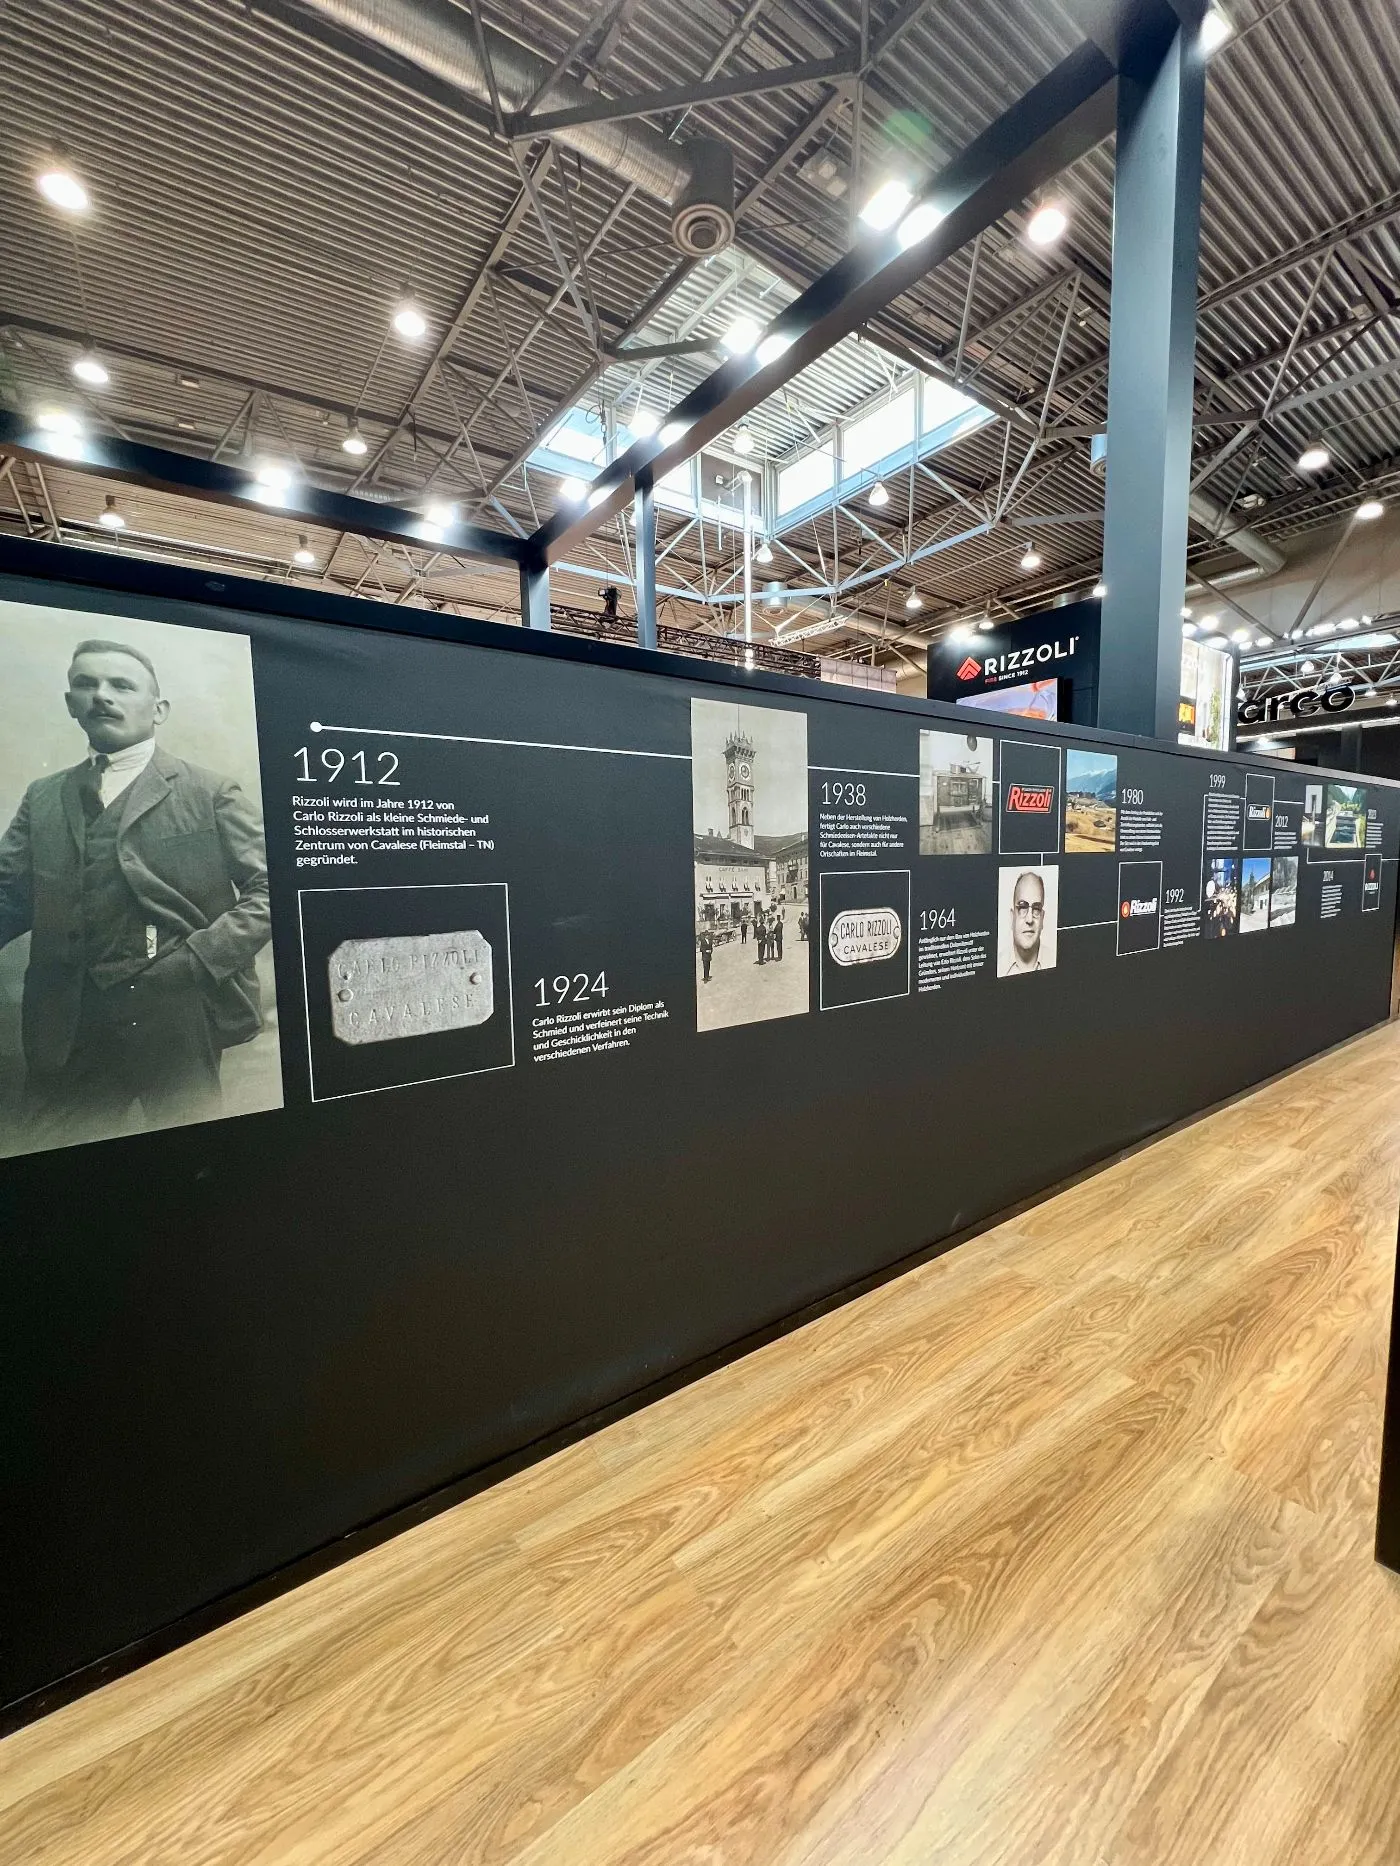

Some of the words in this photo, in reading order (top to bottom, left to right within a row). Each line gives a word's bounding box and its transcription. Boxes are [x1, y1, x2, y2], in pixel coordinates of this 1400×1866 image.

[985, 637, 1076, 676] RIZZOLI
[998, 673, 1016, 681] SINCE
[294, 746, 401, 786] 1912
[1209, 774, 1226, 789] 1999
[821, 781, 866, 806] 1938
[1008, 786, 1052, 811] Rizzoli
[1121, 788, 1144, 805] 1980
[292, 796, 330, 807] Rizzoli
[333, 797, 358, 808] wird
[361, 798, 374, 809] im
[376, 799, 405, 809] Jahre
[407, 800, 434, 810] 1912
[436, 802, 455, 810] von
[293, 811, 325, 822] Carlo
[328, 811, 364, 822] Rizzoli
[366, 812, 382, 822] als
[384, 813, 415, 823] kleine
[417, 814, 468, 824] Schmiede-
[471, 814, 489, 824] und
[819, 813, 837, 821] Neben
[1274, 815, 1289, 828] 2012
[294, 825, 399, 837] Schlosserwerkstatt
[402, 827, 415, 836] im
[417, 827, 476, 837] historischen
[295, 840, 345, 851] Zentrum
[347, 842, 368, 850] von
[371, 840, 417, 850] Cavalese
[420, 839, 466, 851] (Fleimstal
[477, 840, 495, 851] TN)
[296, 854, 358, 867] gegründet.
[1165, 888, 1184, 904] 1992
[919, 907, 956, 931] 1964
[840, 922, 864, 939] CARLO
[867, 919, 892, 937] RIZZOLI
[843, 941, 889, 955] CAVALESE
[534, 970, 610, 1007] 1924
[532, 1016, 555, 1027] Carlo
[556, 1012, 582, 1024] Rizzoli
[583, 1008, 611, 1020] erwirbt
[612, 1006, 627, 1016] sein
[628, 1002, 654, 1013] Diplom
[654, 1000, 665, 1009] als
[532, 1025, 568, 1039] Schmied
[569, 1023, 585, 1033] und
[586, 1017, 622, 1031] verfeinert
[623, 1015, 642, 1024] seine
[644, 1010, 669, 1021] Technik
[533, 1040, 550, 1050] und
[550, 1029, 613, 1048] Geschicklichkeit
[614, 1028, 621, 1036] in
[622, 1026, 637, 1036] den
[533, 1045, 591, 1062] verschiedenen
[592, 1039, 631, 1052] Verfahren.
